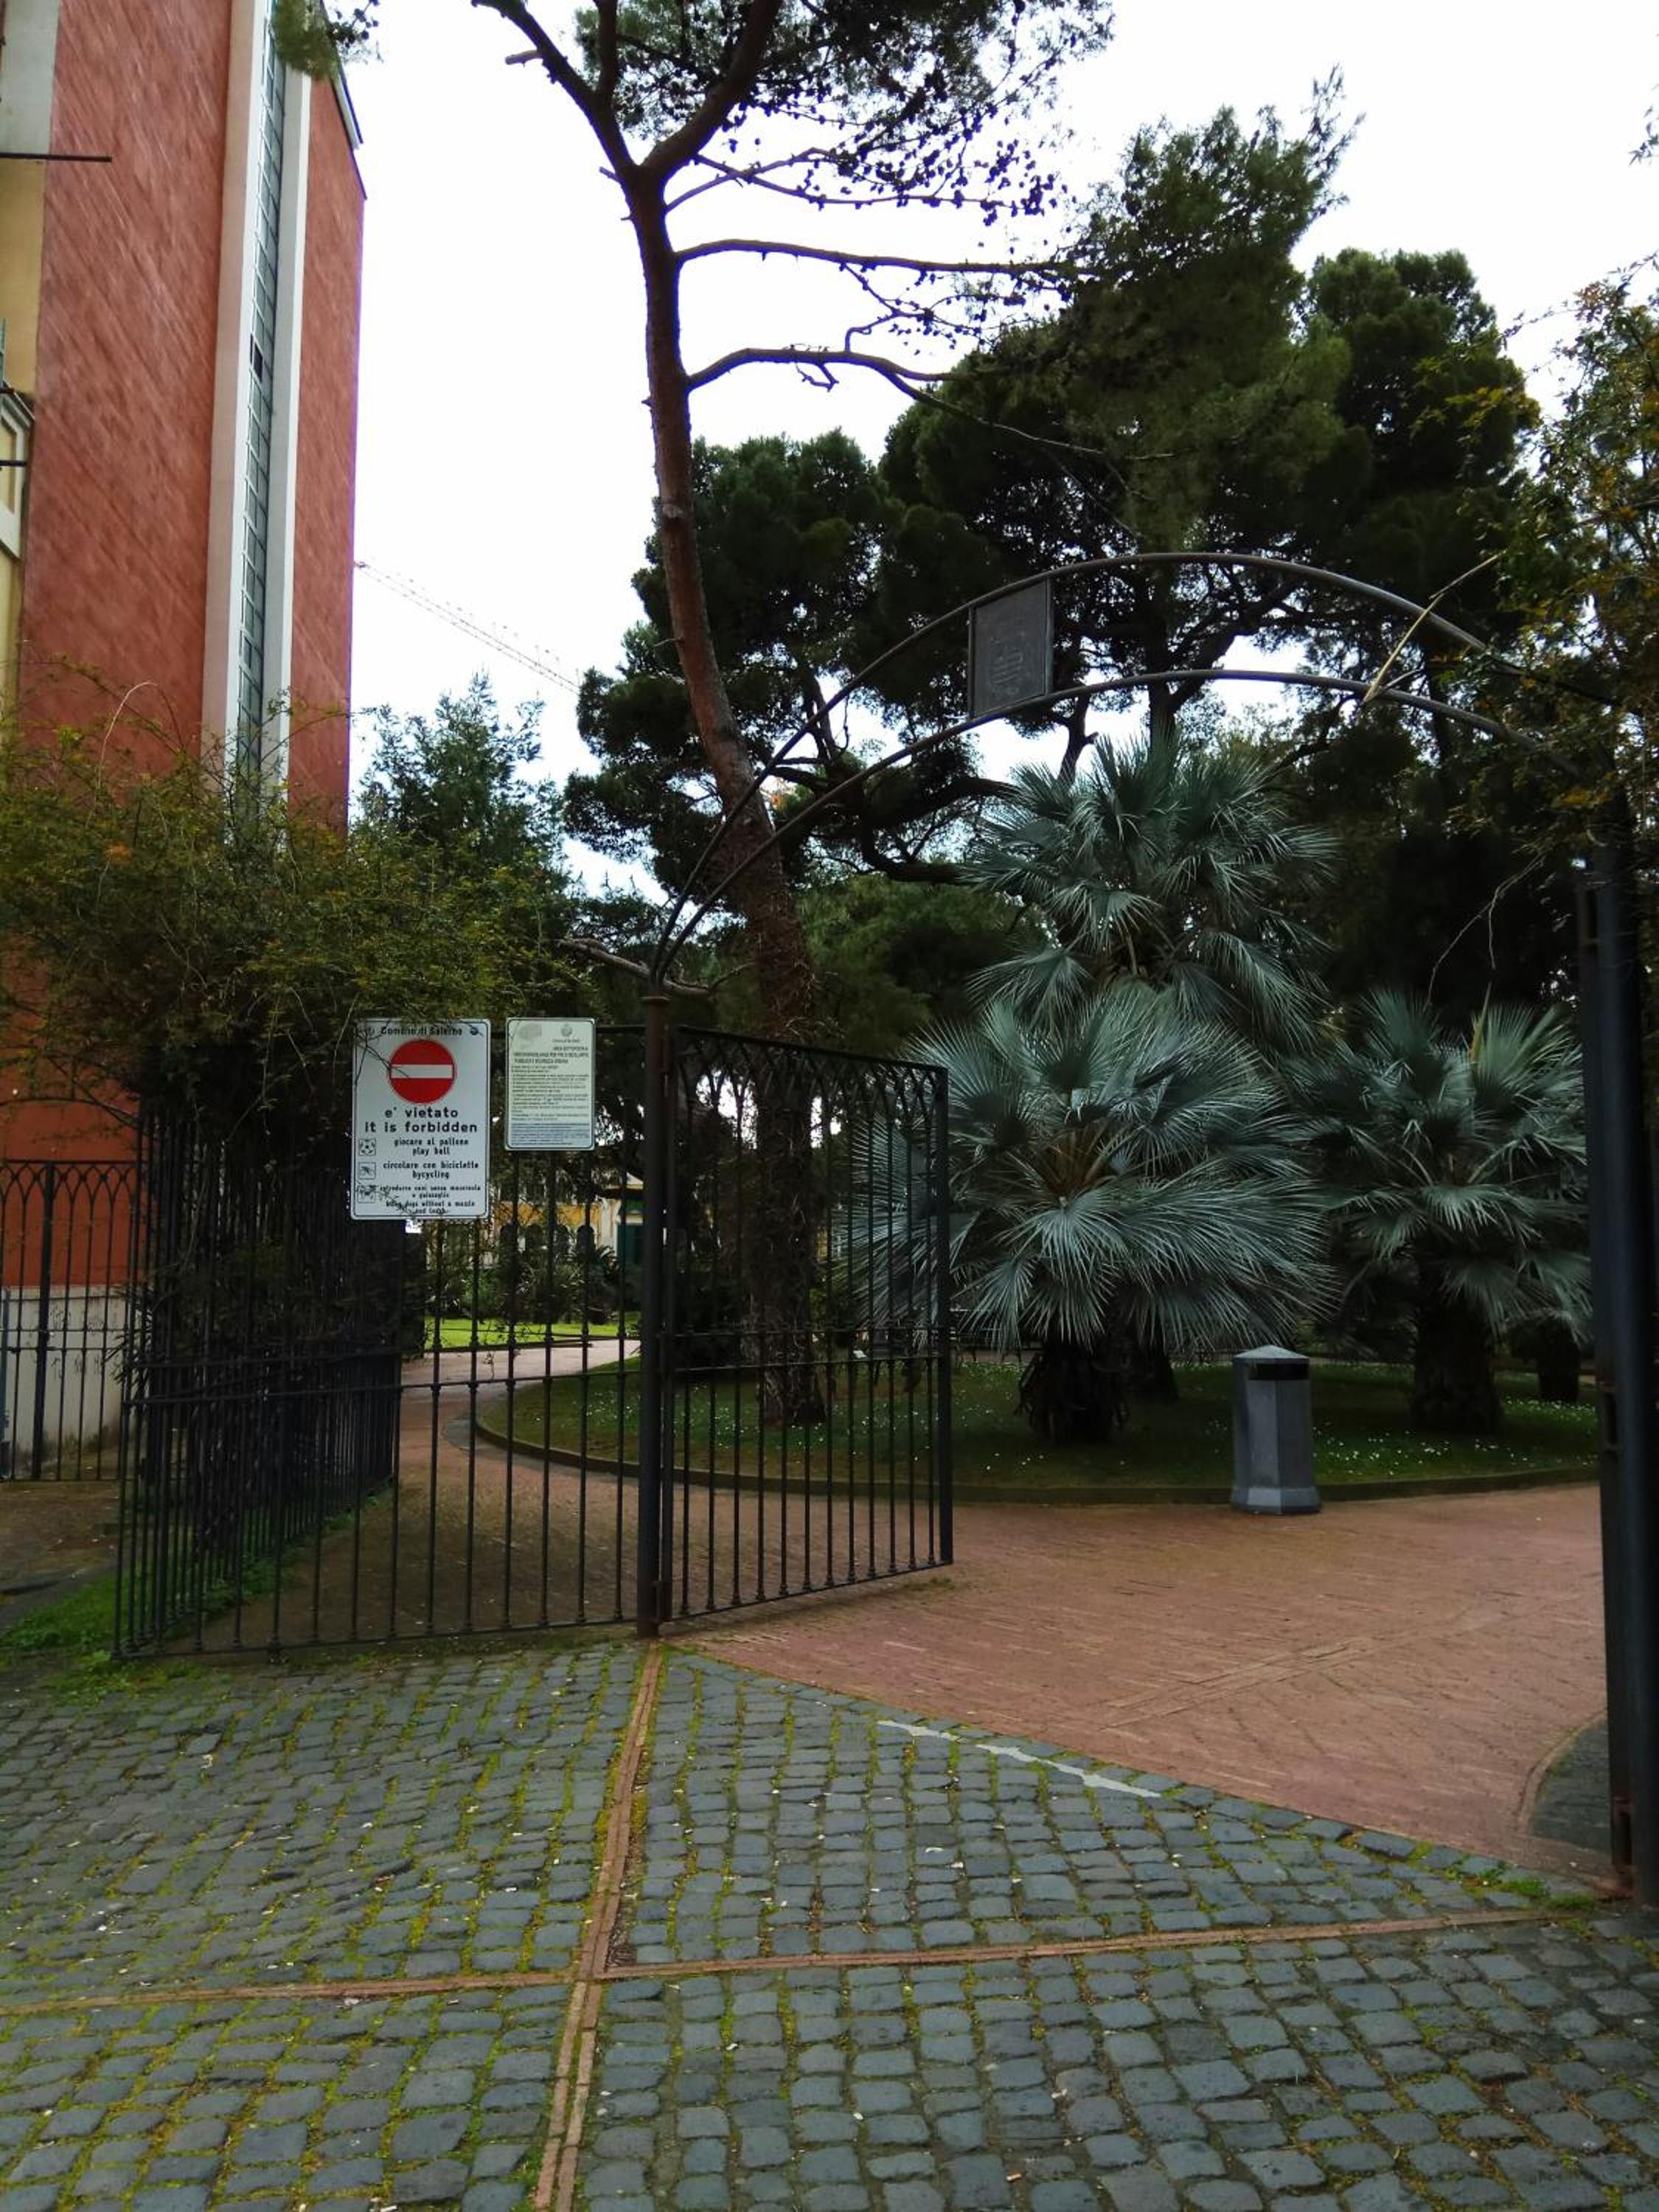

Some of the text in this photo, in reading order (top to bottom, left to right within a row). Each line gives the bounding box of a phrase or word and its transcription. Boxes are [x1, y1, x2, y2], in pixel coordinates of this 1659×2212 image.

[405, 1107, 459, 1118] vietato
[365, 1121, 477, 1133] it is forbidden
[394, 1138, 422, 1147] giocare
[439, 1138, 469, 1147] pallone
[412, 1147, 430, 1156] play
[412, 1170, 450, 1180] bycycling
